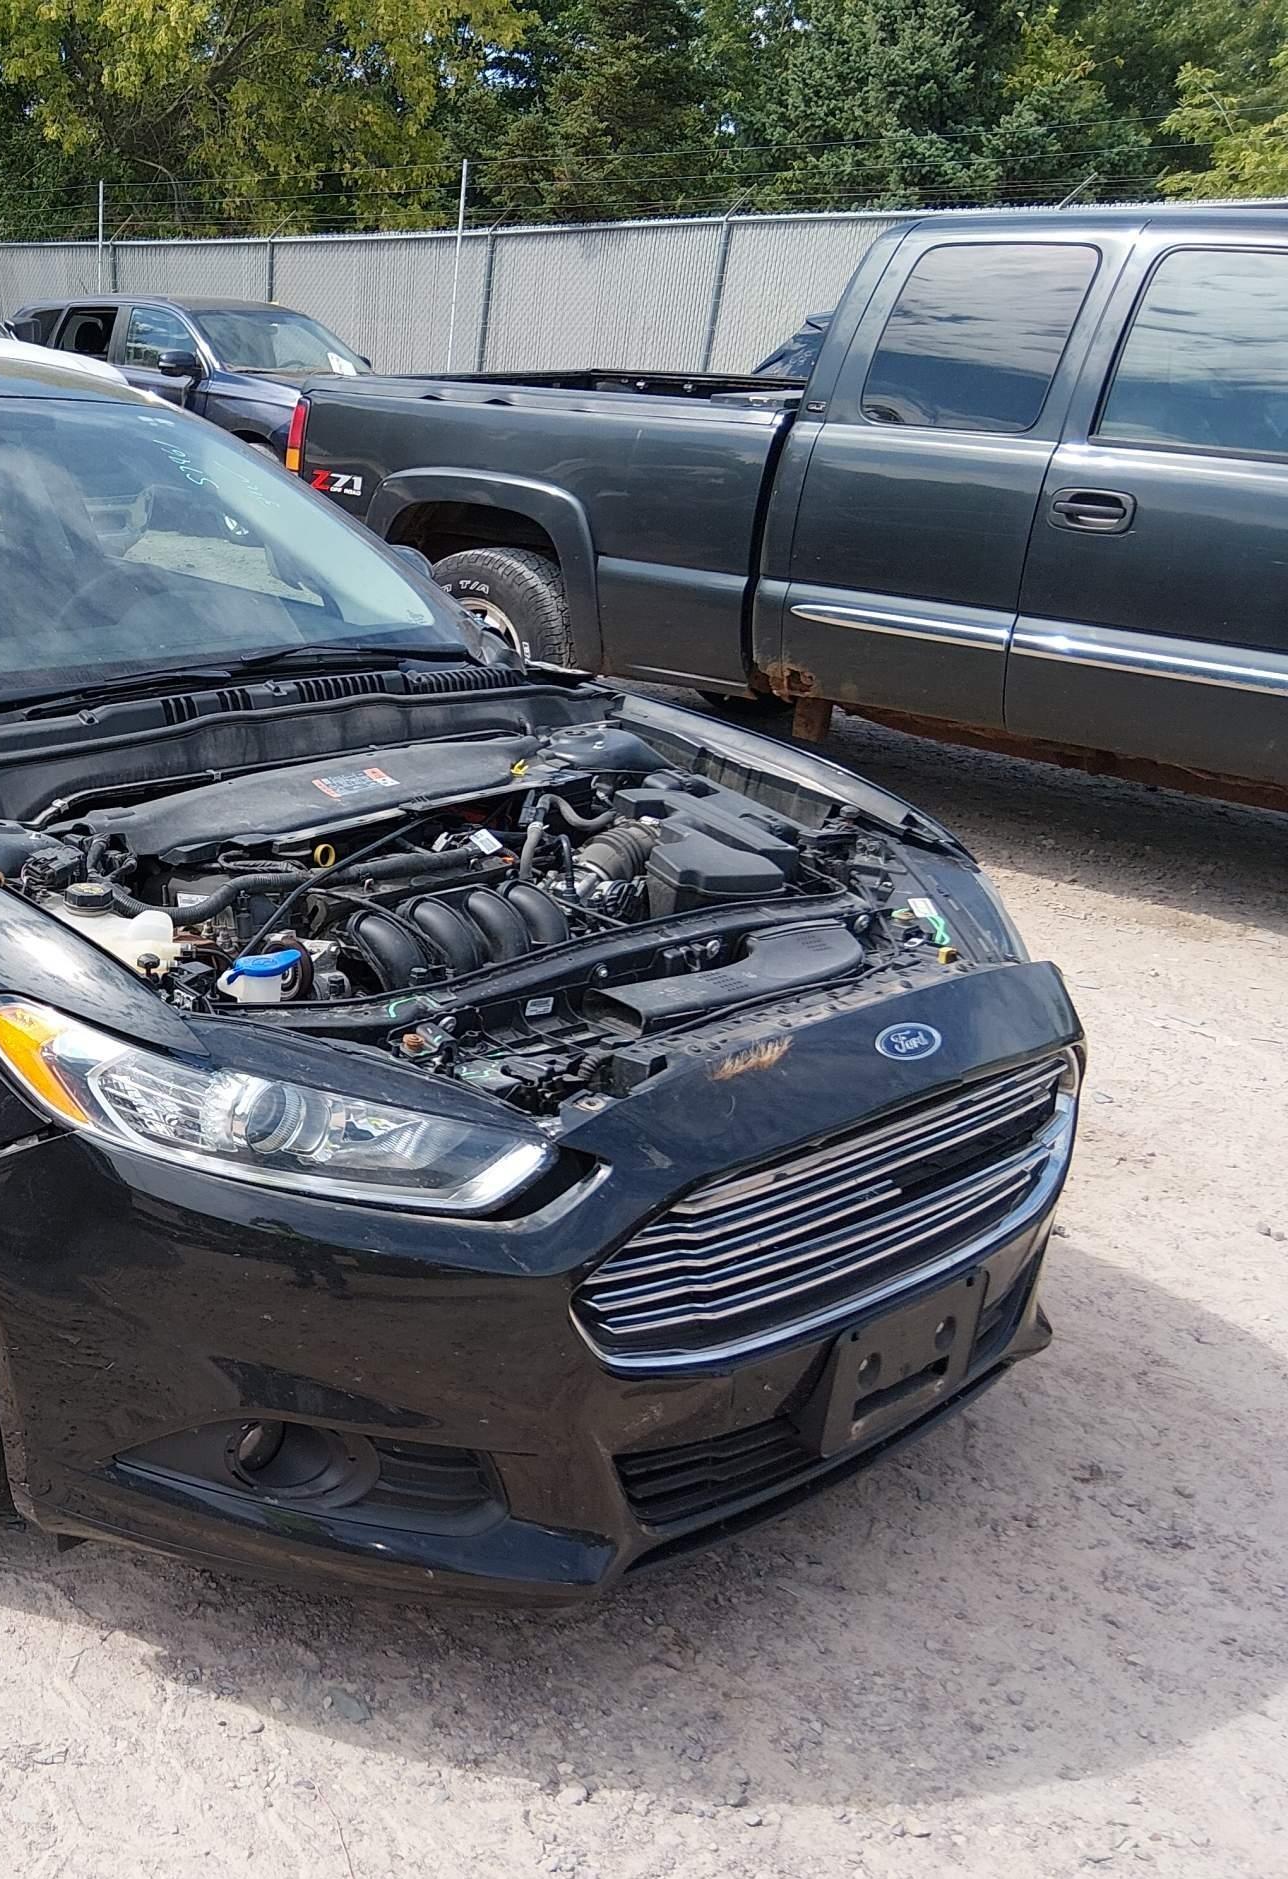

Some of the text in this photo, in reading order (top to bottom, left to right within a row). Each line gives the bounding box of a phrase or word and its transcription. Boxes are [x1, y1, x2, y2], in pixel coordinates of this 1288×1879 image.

[311, 469, 363, 490] Z71
[459, 579, 490, 595] T/A
[890, 1030, 929, 1053] Ford
